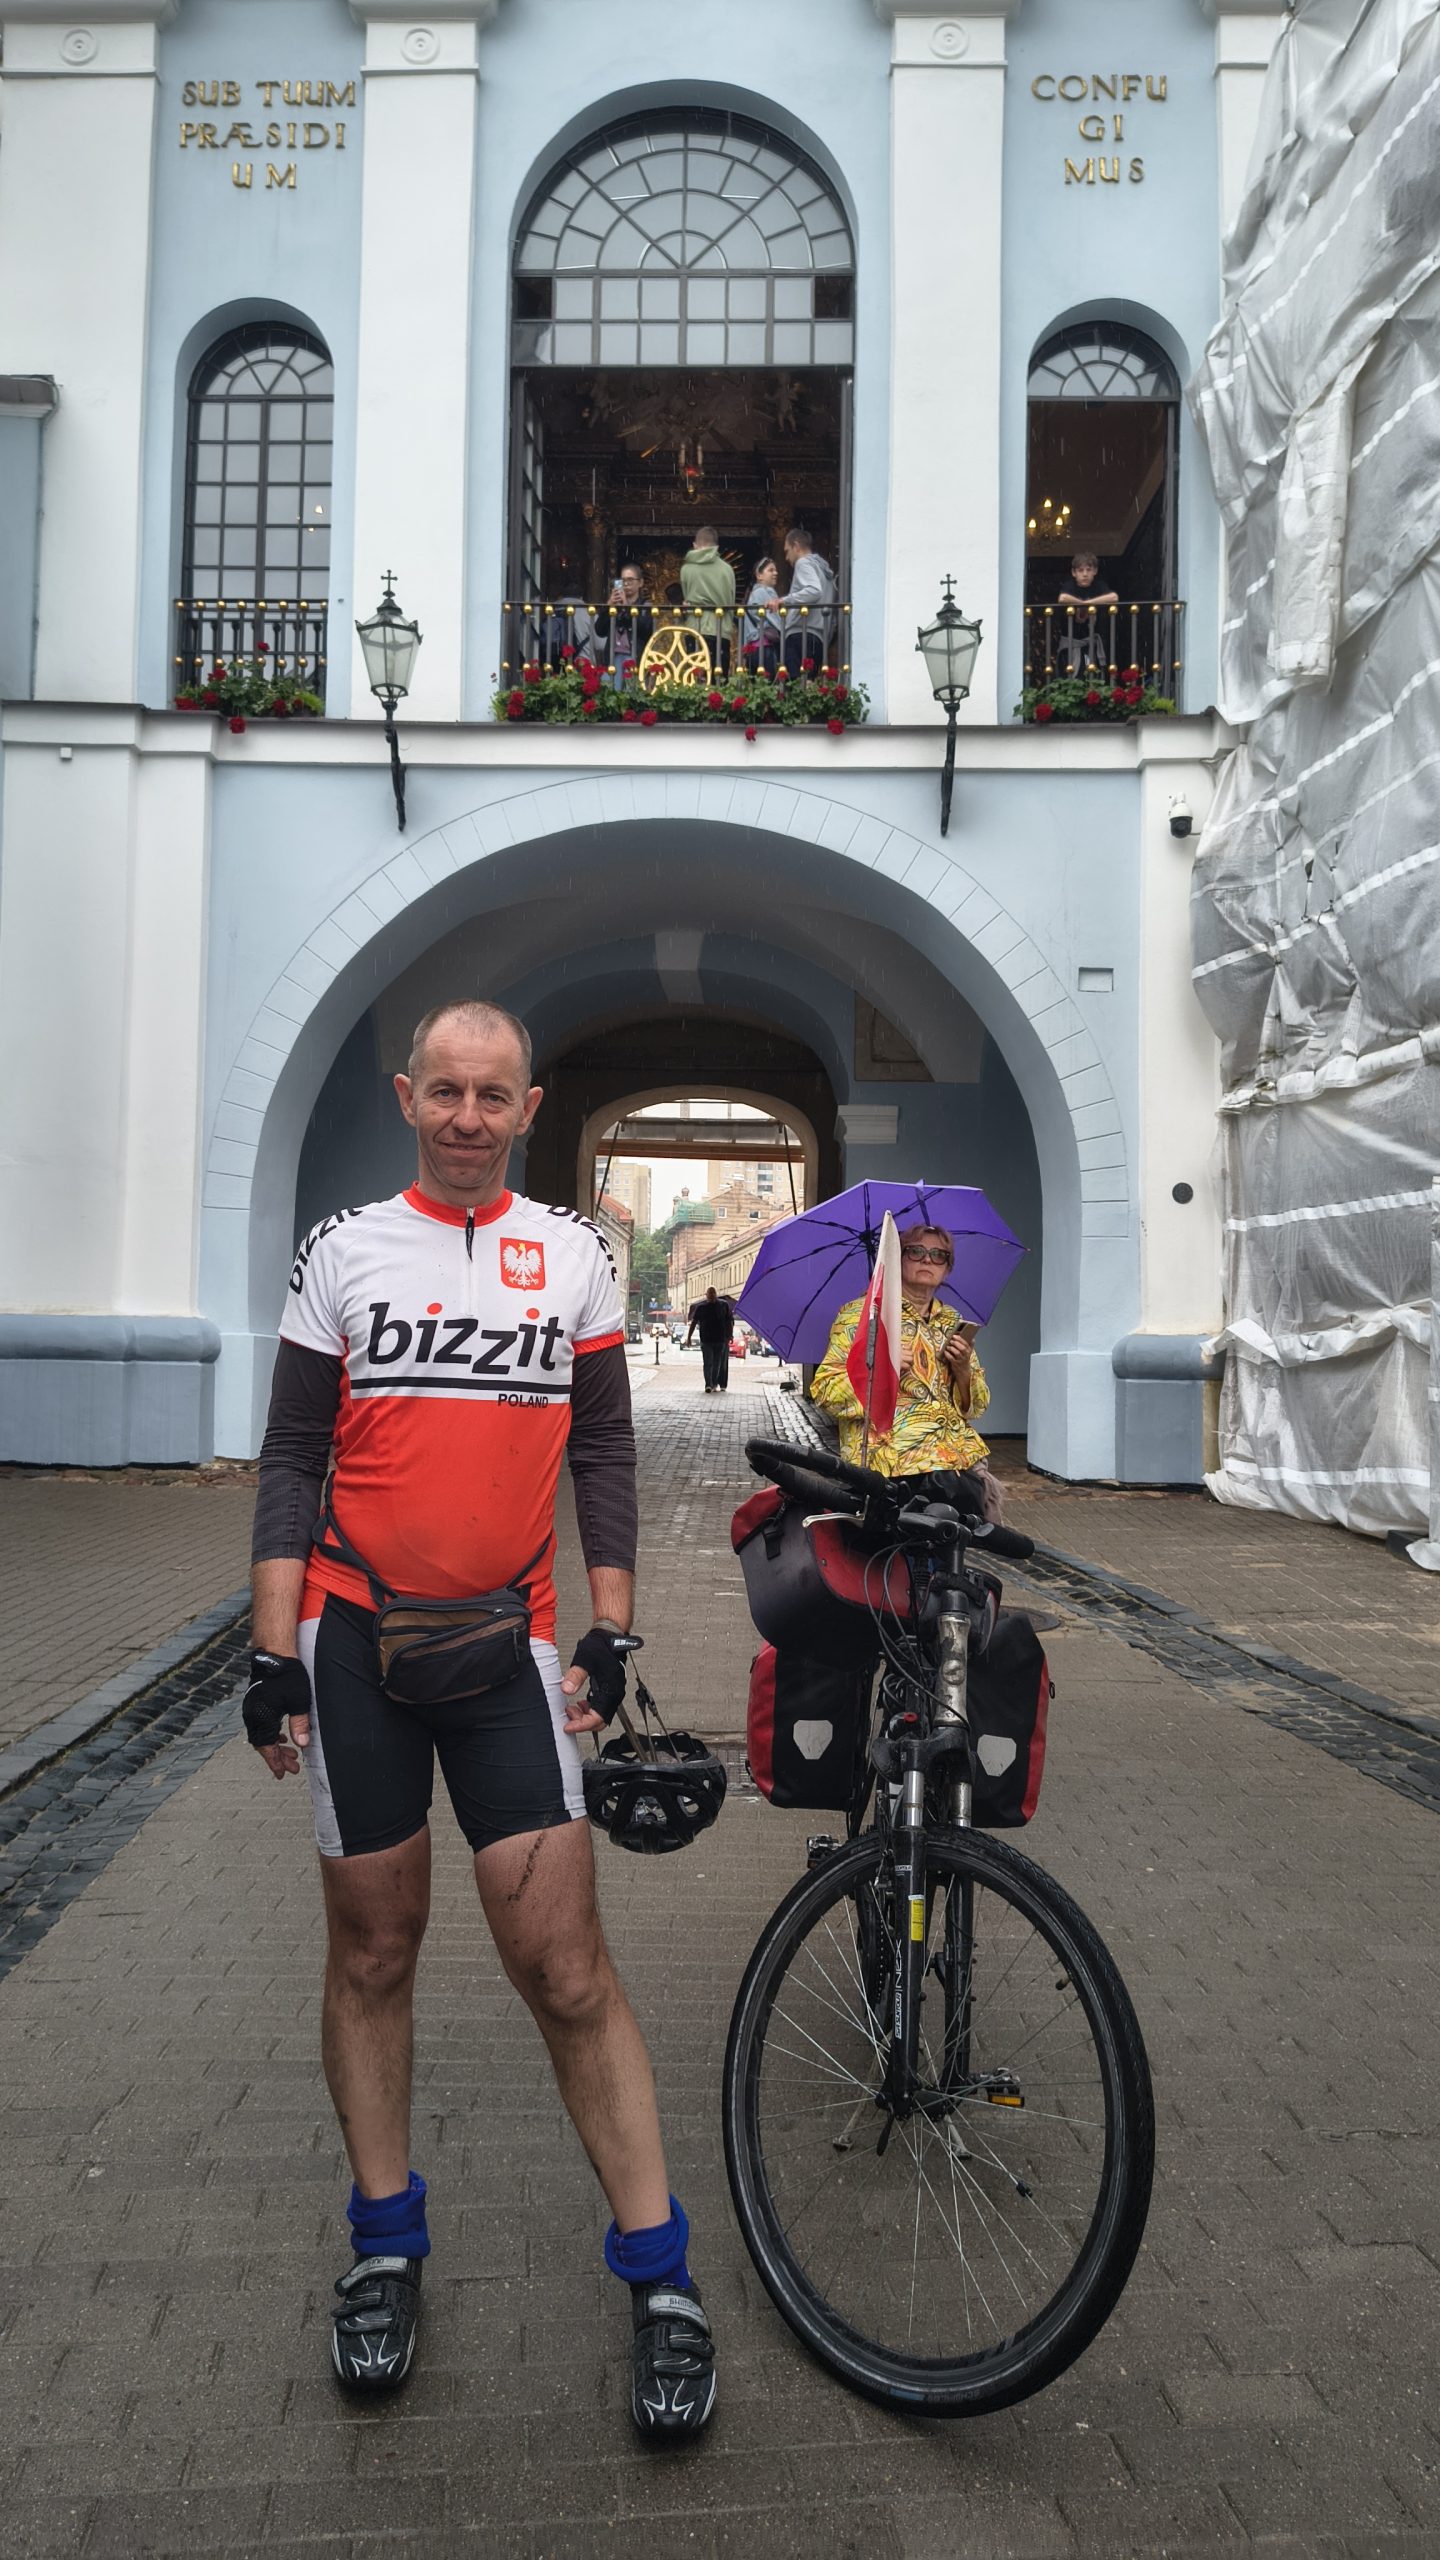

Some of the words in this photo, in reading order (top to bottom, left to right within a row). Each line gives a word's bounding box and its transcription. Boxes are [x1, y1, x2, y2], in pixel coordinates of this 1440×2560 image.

[182, 80, 241, 107] SUB
[255, 80, 356, 107] TUUM
[1031, 74, 1167, 101] CONFU
[179, 122, 346, 149] PRÆSIDI
[1064, 157, 1144, 185] MUS
[367, 1302, 564, 1375] bizzit
[498, 1393, 549, 1408] POLAND
